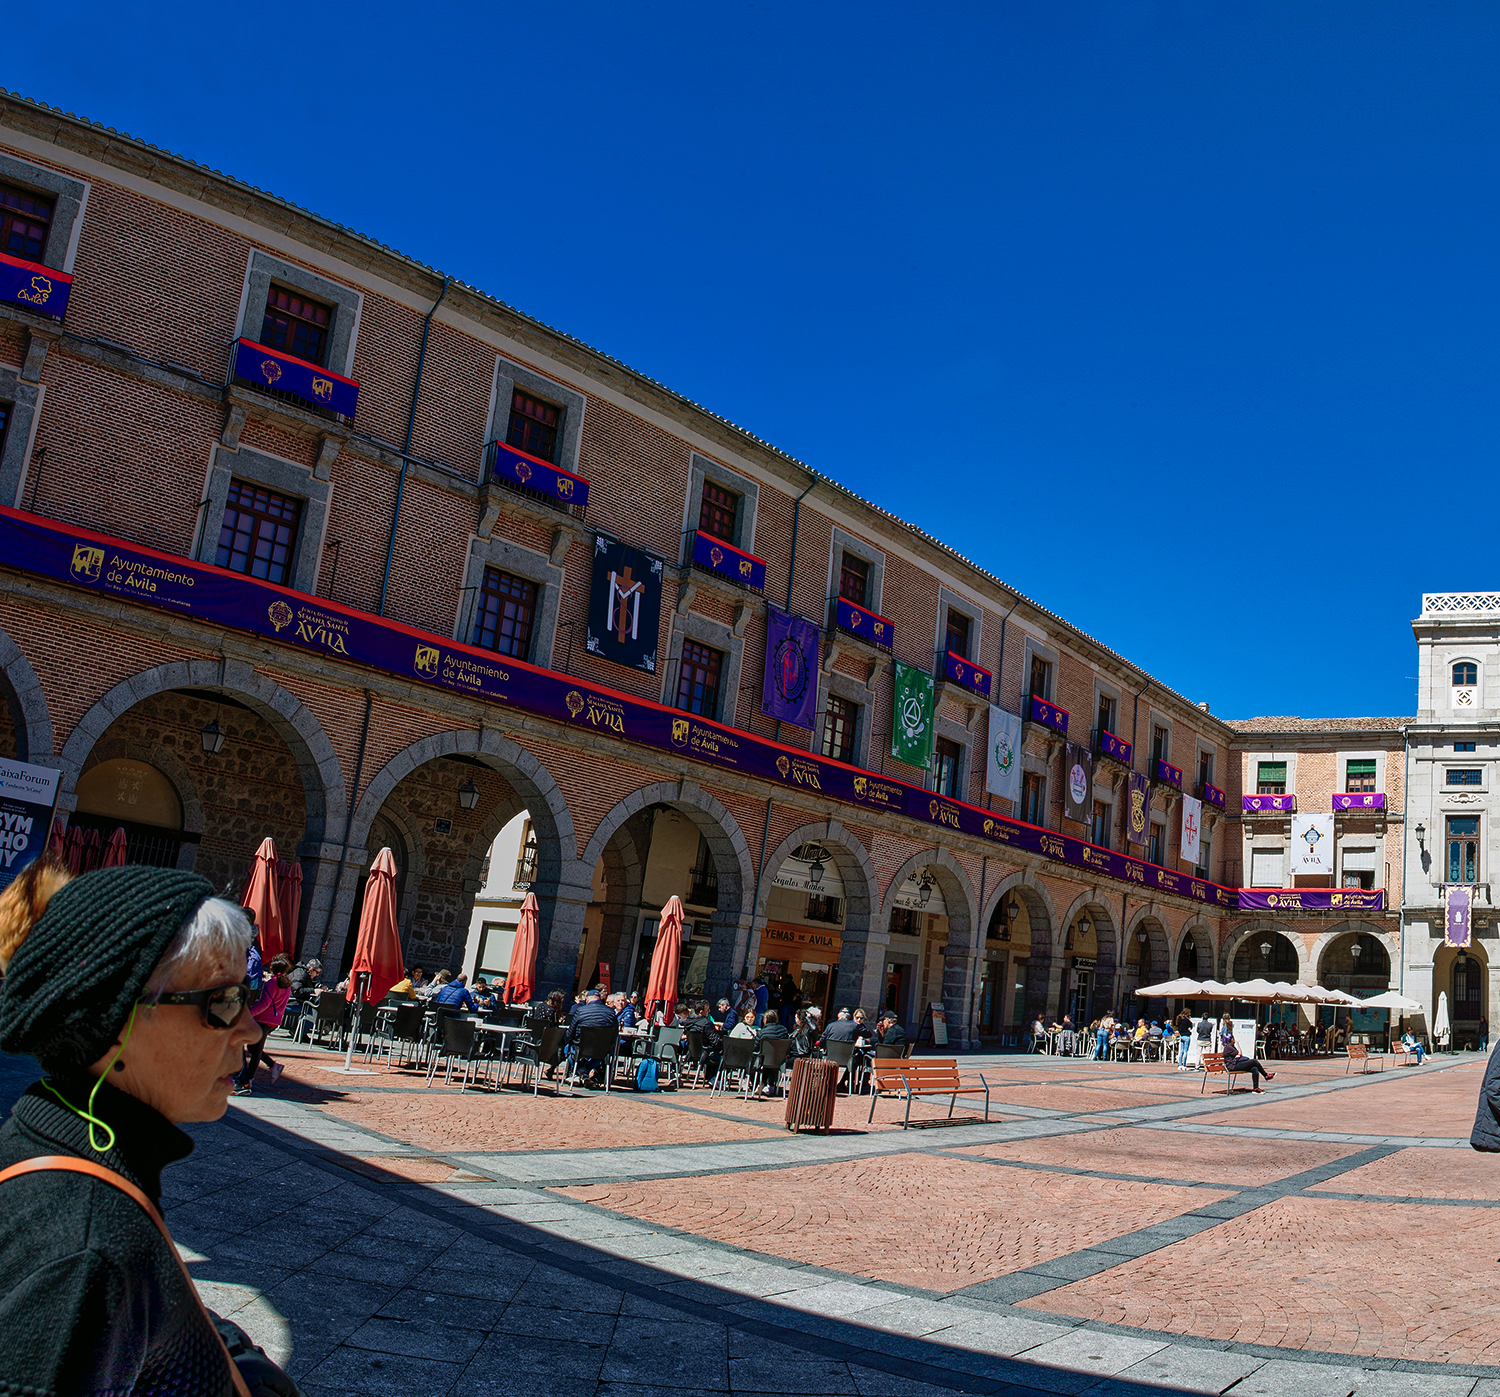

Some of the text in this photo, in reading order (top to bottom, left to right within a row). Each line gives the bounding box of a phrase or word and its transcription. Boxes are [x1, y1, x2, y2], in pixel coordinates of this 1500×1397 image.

[107, 570, 156, 592] de Ávila
[110, 555, 194, 586] Ayuntamiento
[297, 611, 349, 635] SEMANA SANTA
[295, 619, 349, 655] ÁVILA
[443, 667, 481, 686] de Ávila
[444, 654, 509, 681] Ayuntamiento
[586, 705, 625, 733] ÁVILA
[691, 736, 719, 752] de Ávila
[692, 725, 738, 748] Ayuntamiento
[0, 766, 50, 786] aixaForum
[792, 768, 821, 790] ÁVILA
[868, 790, 888, 801] de Ávila
[869, 780, 902, 796] Ayuntamiento
[765, 929, 795, 941] YEMAS
[809, 935, 833, 946] AVILA
